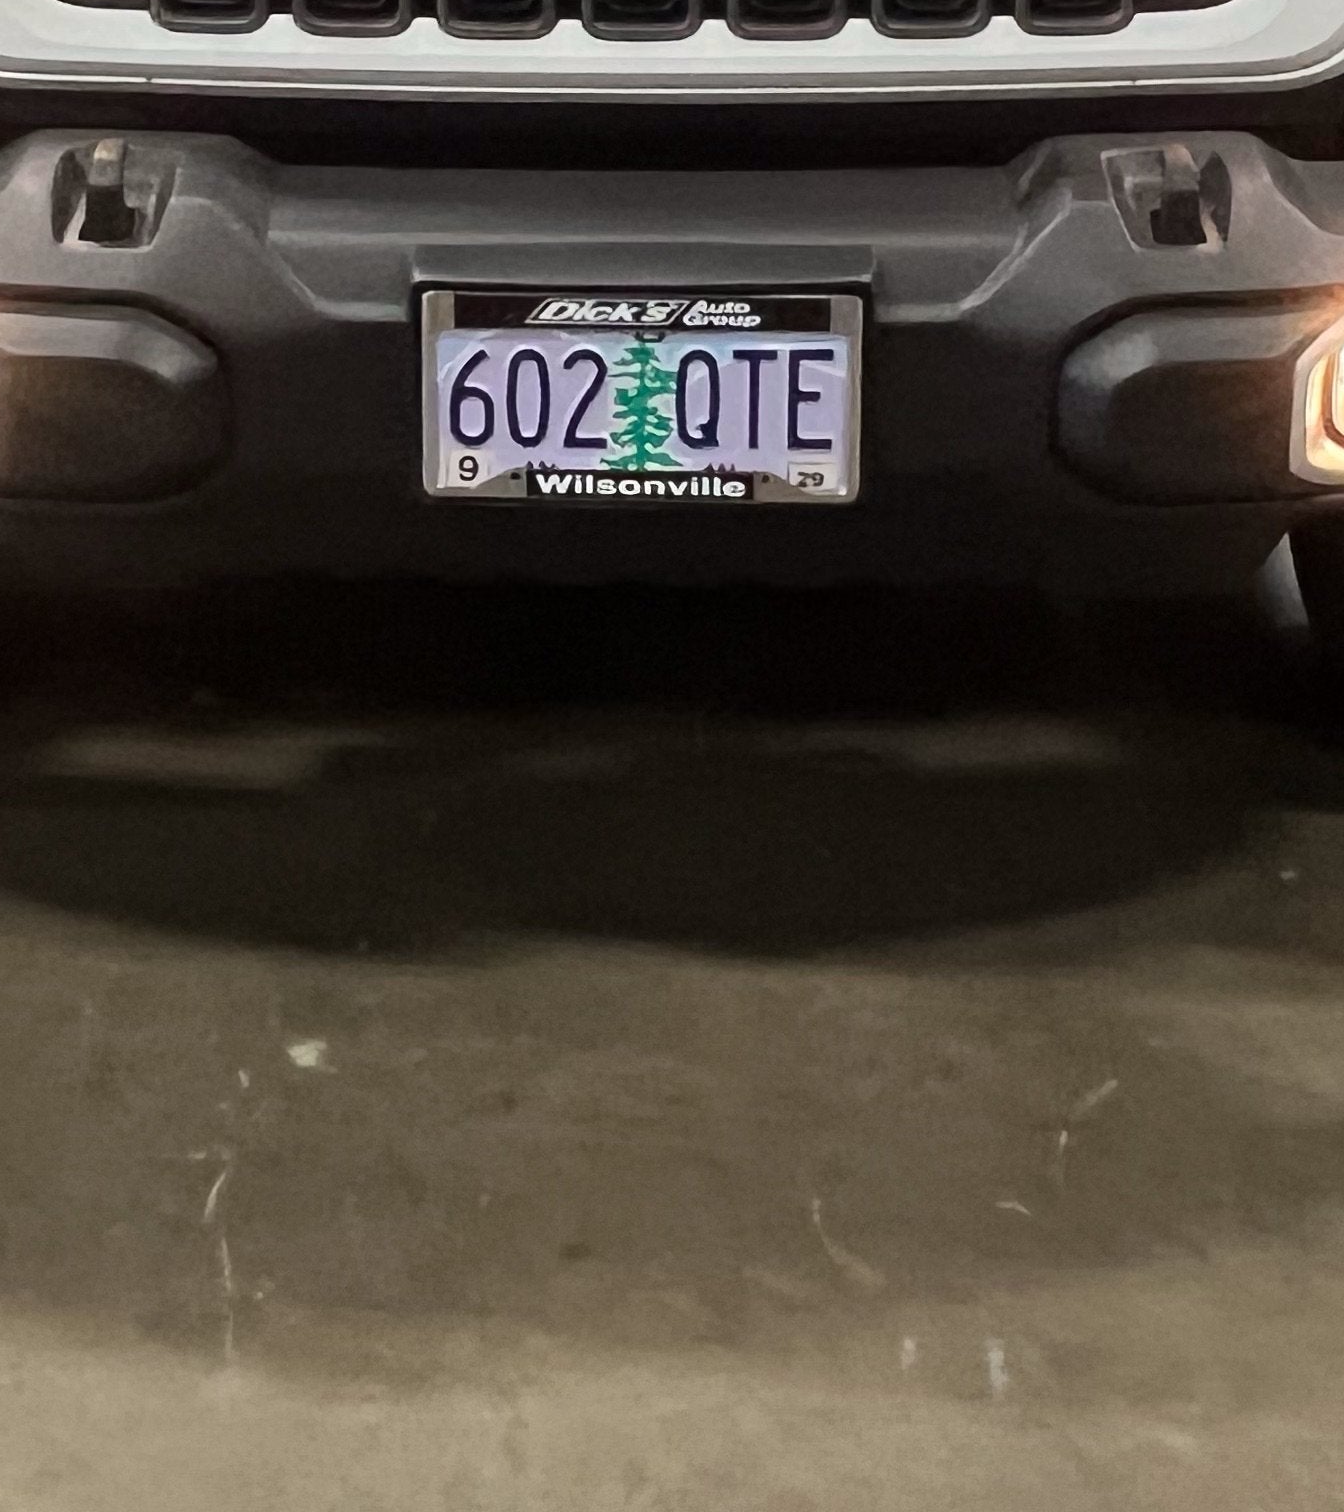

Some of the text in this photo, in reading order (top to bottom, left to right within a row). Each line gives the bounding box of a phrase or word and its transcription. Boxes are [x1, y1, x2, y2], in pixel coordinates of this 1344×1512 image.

[537, 300, 681, 322] Dick's
[697, 300, 751, 314] Auto
[682, 312, 762, 328] Group
[449, 348, 835, 451] 602 QTE
[458, 455, 481, 482] 9
[535, 473, 747, 498] Wilsonville
